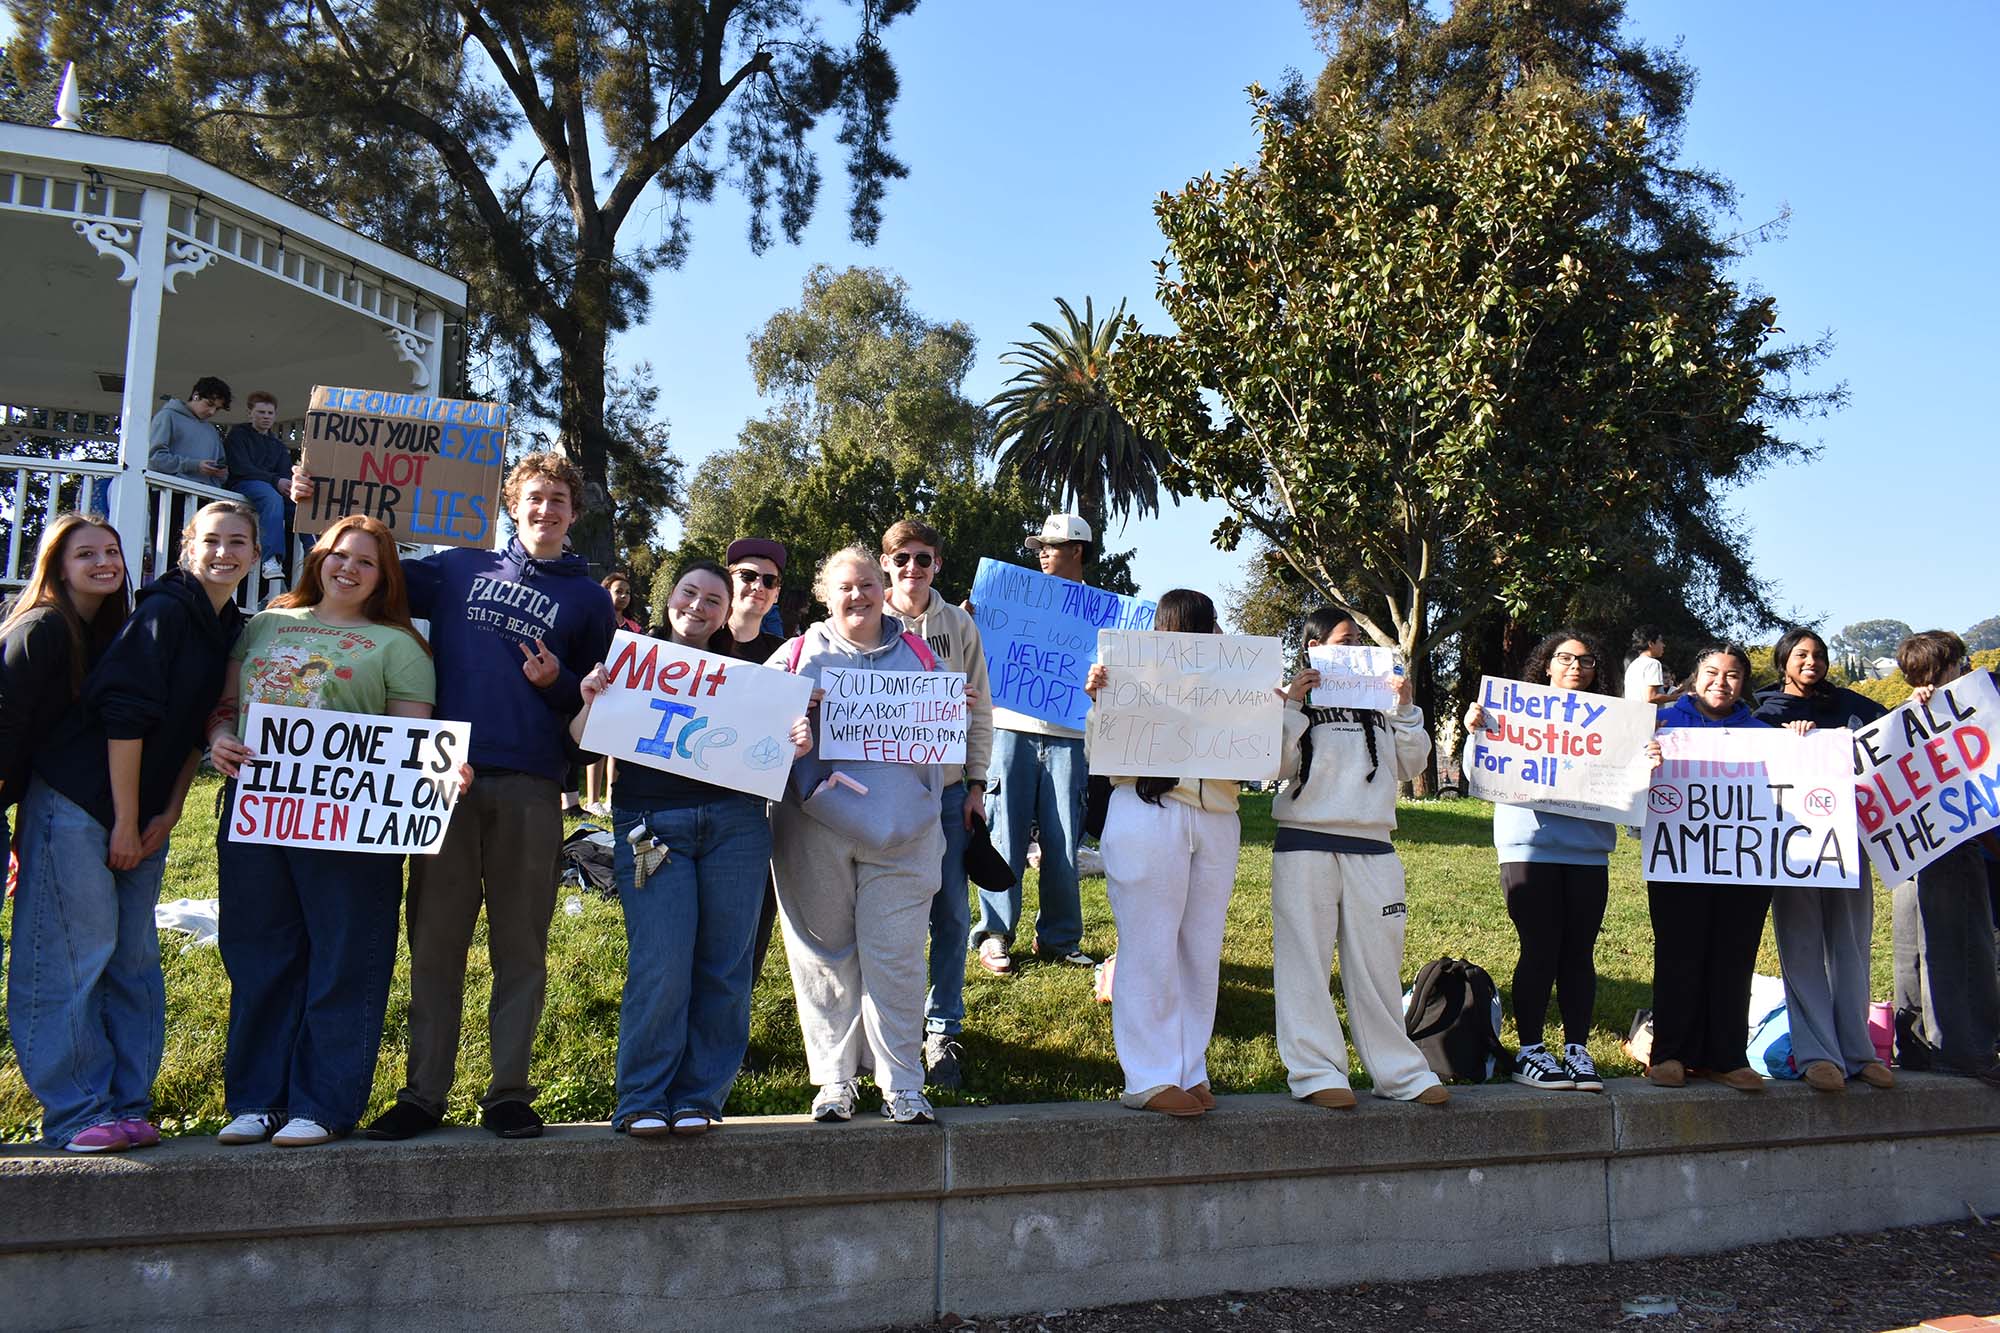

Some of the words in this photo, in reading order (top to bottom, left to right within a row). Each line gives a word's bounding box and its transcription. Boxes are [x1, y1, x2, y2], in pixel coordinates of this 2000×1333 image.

[308, 412, 384, 446] TRUST
[384, 421, 440, 454] YOUR
[439, 424, 504, 466] EYES
[360, 451, 429, 486] NOT
[310, 476, 400, 529] THEIR
[410, 488, 489, 542] LIES
[466, 578, 560, 629] PACIFICA
[998, 567, 1033, 607] NAME
[1036, 578, 1055, 610] IS
[278, 625, 342, 636] KINDNESS
[467, 606, 504, 627] STATE
[505, 616, 546, 640] BEACH
[974, 601, 1009, 630] AND
[1013, 619, 1037, 639] I
[1047, 625, 1097, 653] WOU
[607, 641, 727, 697] Melt
[1008, 641, 1079, 680] NEVER
[1150, 636, 1206, 670] TAKE
[1218, 642, 1263, 671] MY
[826, 670, 865, 698] YOU
[912, 676, 939, 696] GET
[943, 677, 965, 699] TO
[985, 655, 1081, 718] UPPORT
[1099, 679, 1219, 709] HORCHATA
[1222, 688, 1274, 705] WARM
[1484, 680, 1607, 729] Liberty
[635, 698, 738, 771] Ice
[830, 724, 874, 741] WHEN
[877, 725, 888, 738] U
[892, 725, 934, 742] VOTED
[957, 730, 967, 744] A
[859, 702, 910, 720] ABOUT
[1486, 715, 1603, 757] Justice
[1901, 689, 1976, 748] ALL
[260, 717, 314, 757] NO
[322, 722, 393, 765] ONE
[401, 728, 457, 774] IS
[864, 740, 948, 764] FELON
[1120, 714, 1169, 768] ICE
[1474, 744, 1512, 774] For
[243, 759, 403, 808] ILLEGAL
[412, 777, 458, 811] ON
[1651, 792, 1678, 807] ICE
[1688, 784, 1794, 822] BUILT
[1809, 795, 1832, 808] ICE
[1855, 725, 1991, 834] BLEED
[236, 794, 349, 842] STOLEN
[357, 809, 442, 847] LAND
[1870, 802, 1946, 872] THE
[1938, 762, 2000, 834] SAM
[1649, 821, 1847, 880] AMERICA
